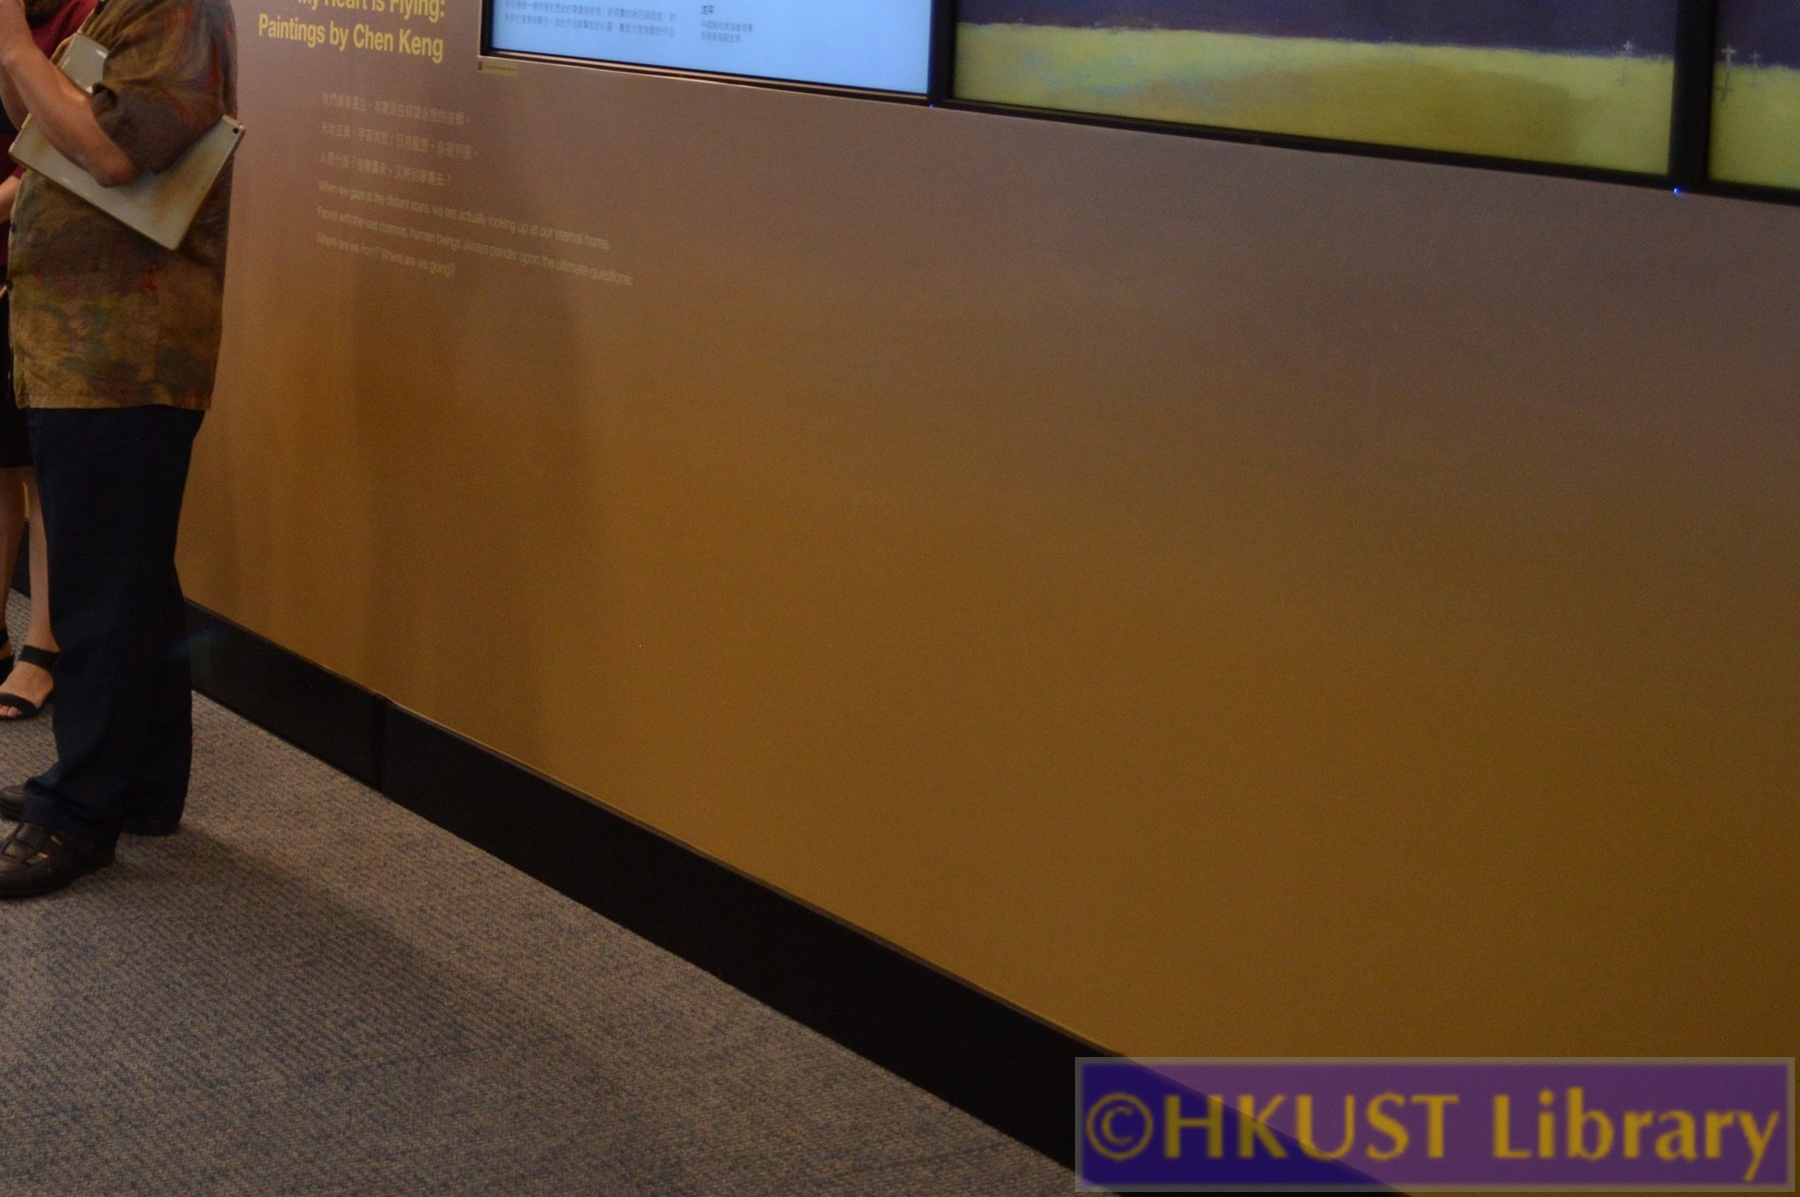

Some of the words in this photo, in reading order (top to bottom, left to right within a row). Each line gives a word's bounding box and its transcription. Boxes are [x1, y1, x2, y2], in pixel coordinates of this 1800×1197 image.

[258, 14, 326, 48] Paintings
[329, 20, 349, 51] by
[353, 23, 393, 52] Chen
[398, 28, 444, 64] Keng
[445, 207, 457, 219] are
[458, 209, 486, 227] actually
[488, 214, 517, 234] looking
[518, 222, 529, 235] up
[539, 226, 554, 238] our
[555, 228, 583, 245] eternal
[519, 252, 541, 266] upon
[542, 255, 555, 269] the
[556, 259, 589, 276] ultimate
